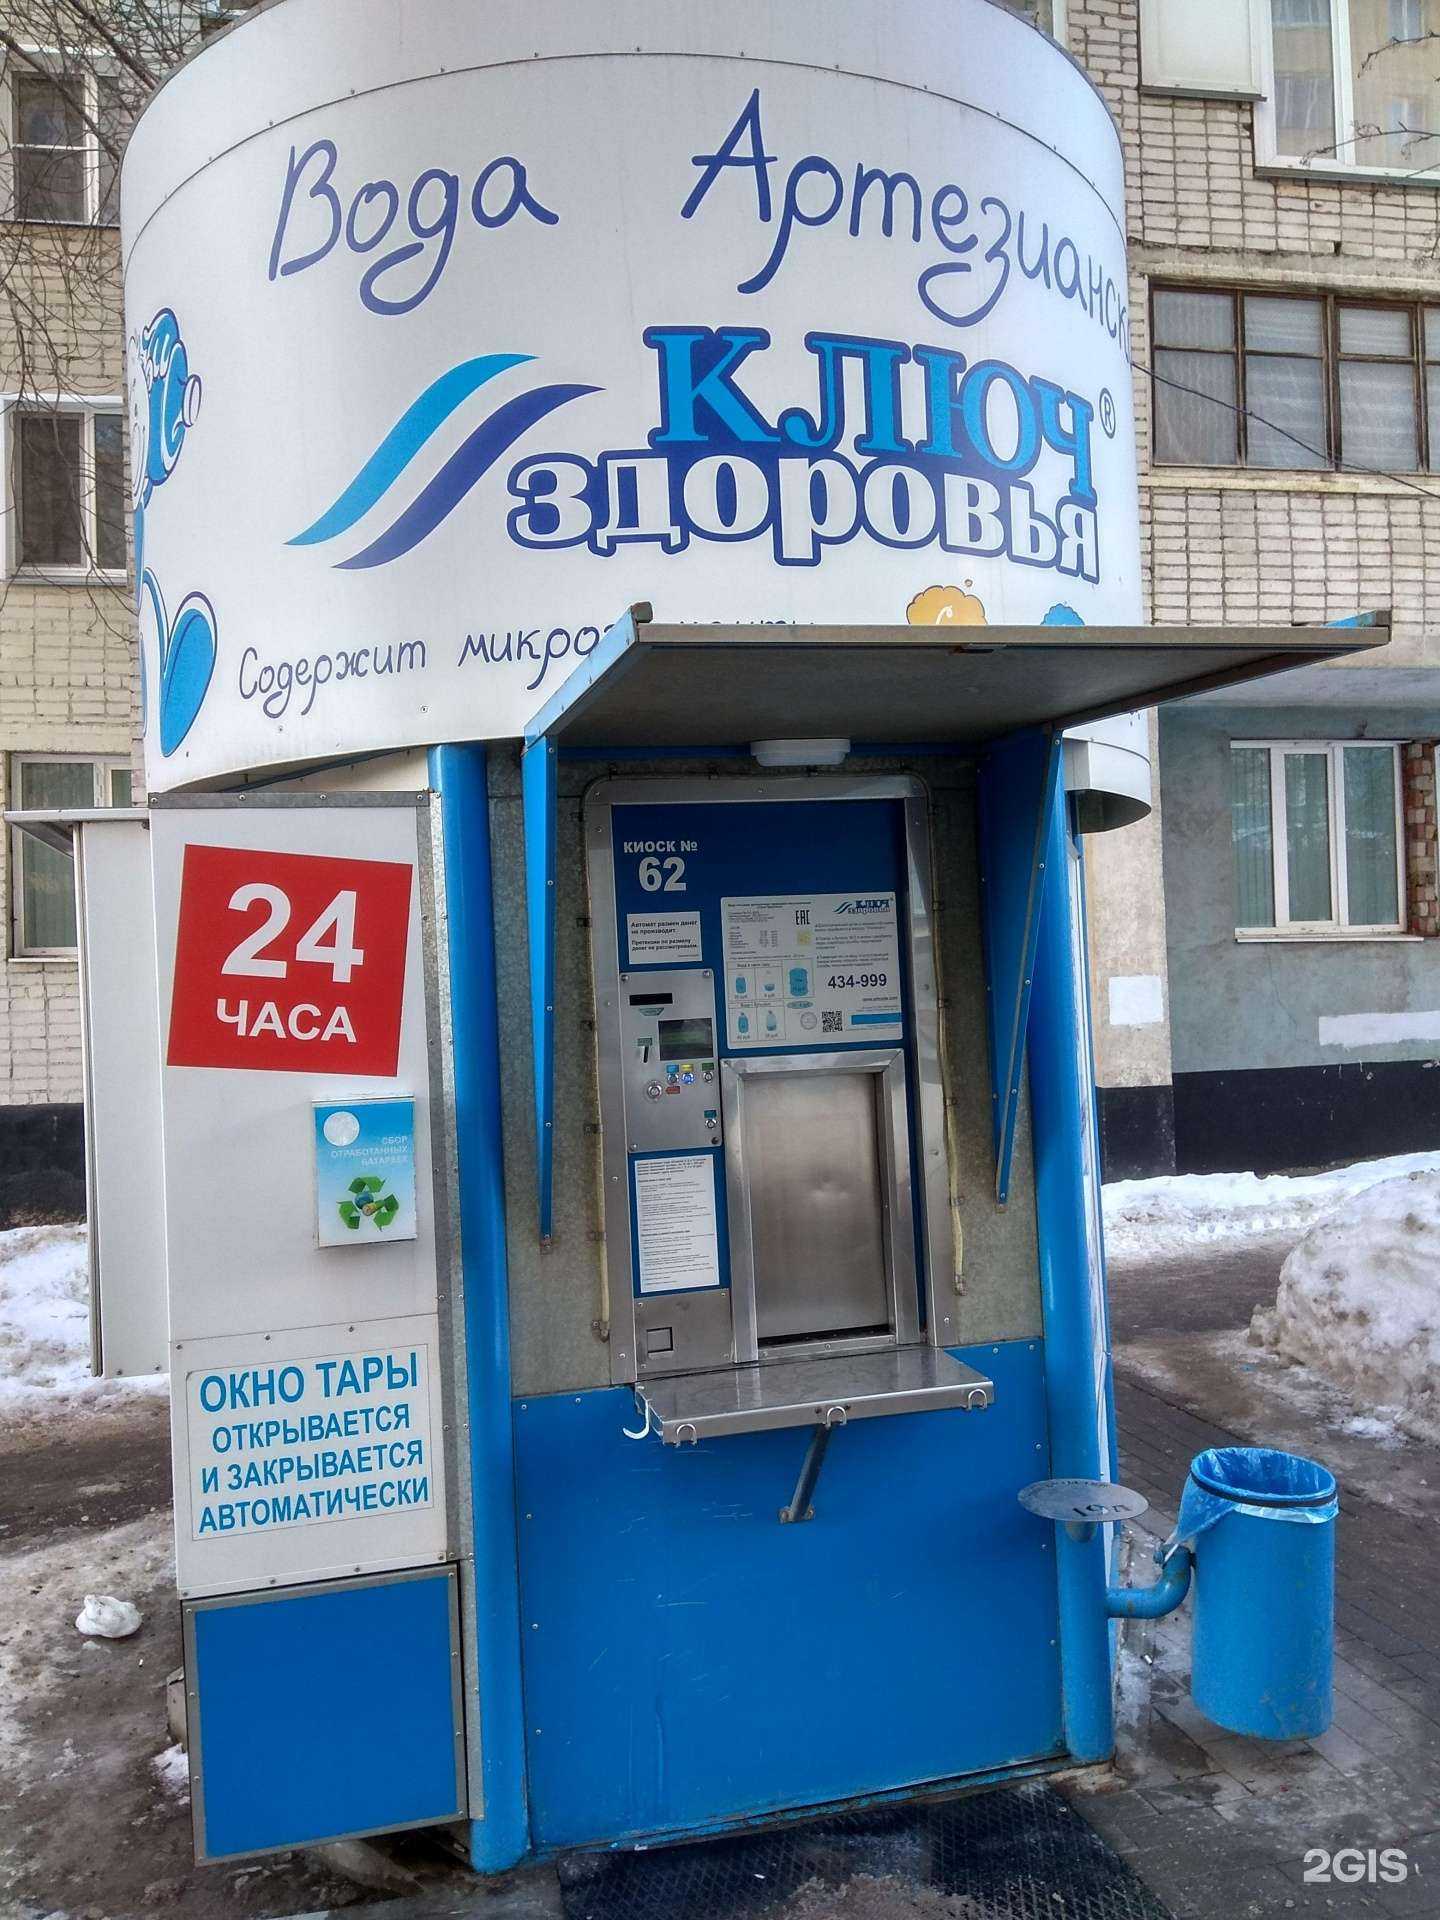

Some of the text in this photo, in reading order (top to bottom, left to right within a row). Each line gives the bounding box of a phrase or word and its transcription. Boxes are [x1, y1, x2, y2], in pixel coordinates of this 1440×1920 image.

[269, 139, 559, 315] Вода
[643, 326, 1096, 501] КЛЮЧ
[239, 639, 427, 719] Содержит
[623, 840, 676, 854] КИОСК
[638, 856, 687, 892] 62
[220, 882, 364, 983] 24
[827, 973, 888, 989] 434-999
[216, 998, 357, 1043] ЧАСА
[200, 1352, 418, 1413] ОКНО ТАРЫ
[212, 1403, 410, 1453] ОТКРЫВАЕТСЯ
[202, 1439, 423, 1494] И ЗАКРЫВАЕТСЯ
[199, 1476, 429, 1534] АВТОМАТИЧЕСКИ
